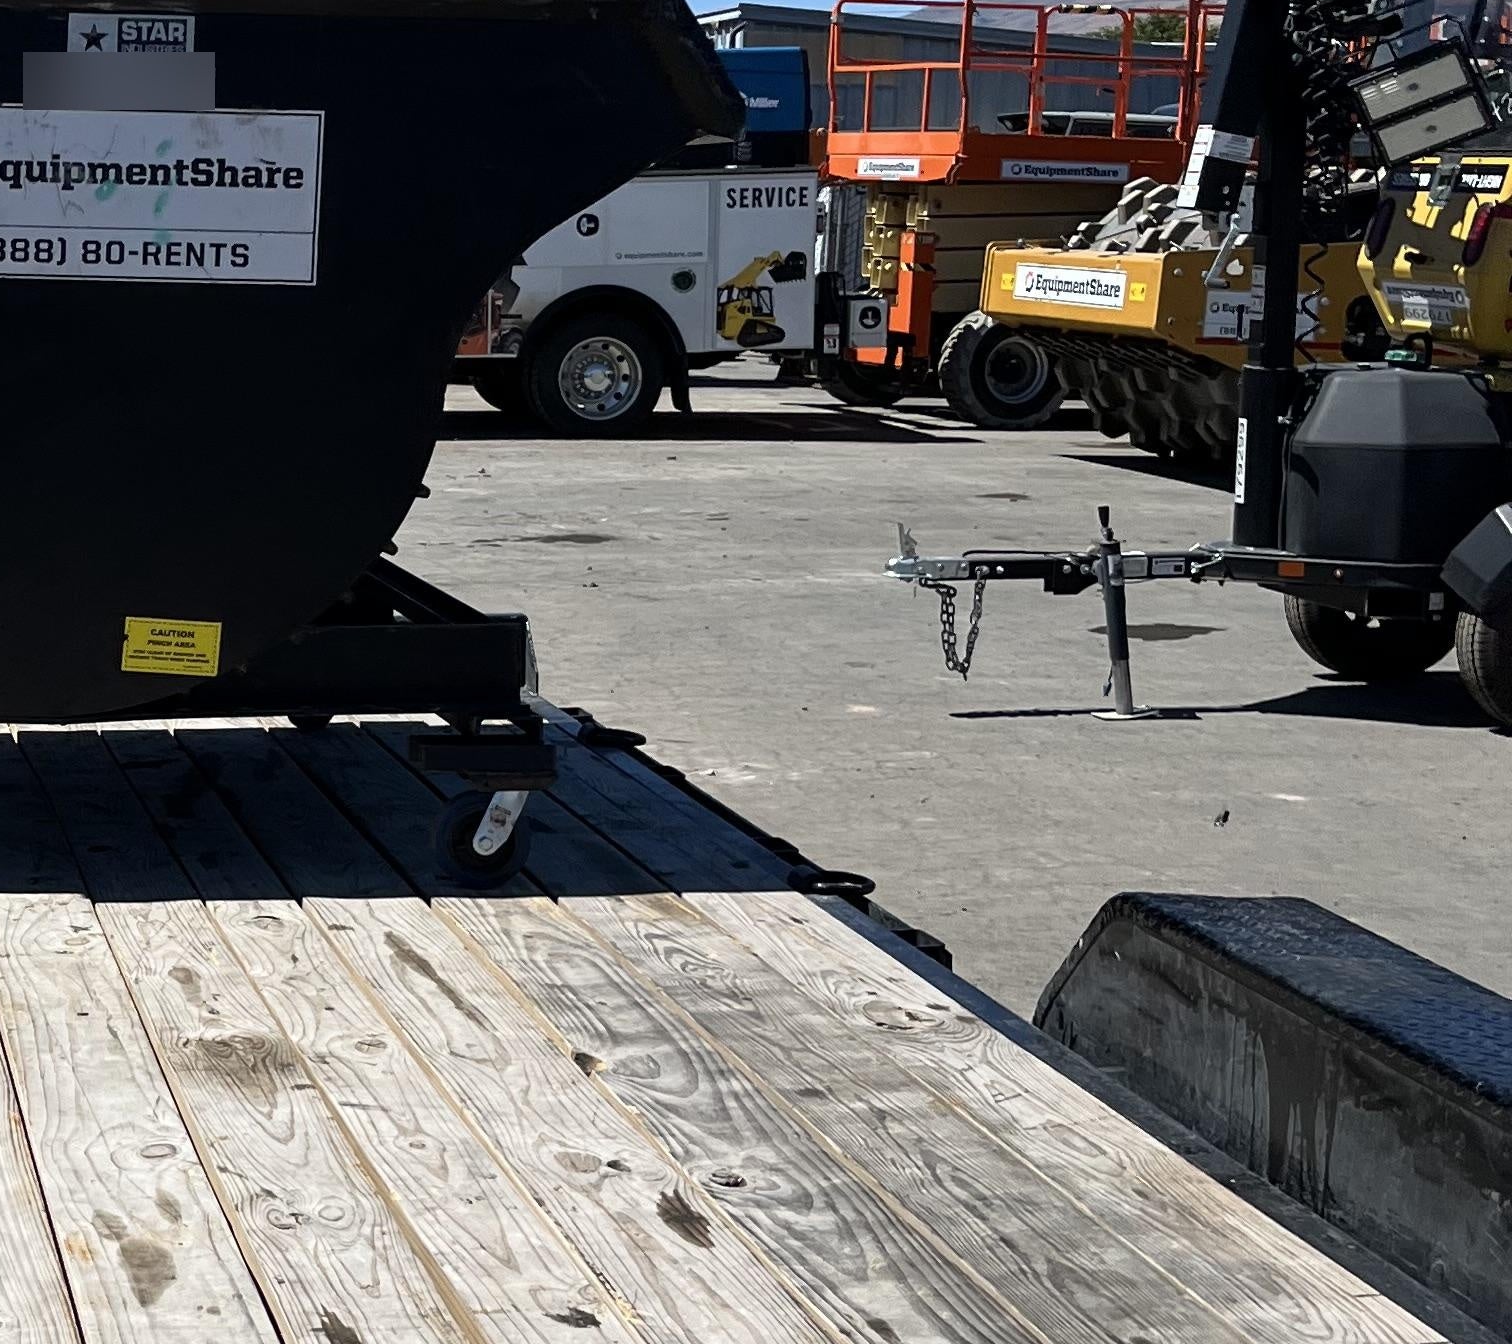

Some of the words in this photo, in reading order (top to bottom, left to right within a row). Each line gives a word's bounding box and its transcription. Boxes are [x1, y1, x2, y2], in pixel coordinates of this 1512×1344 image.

[121, 20, 185, 42] STAR
[1024, 164, 1120, 177] EquipmentShare
[726, 186, 809, 209] SERVICE
[81, 240, 250, 268] 80-RENTS
[1035, 273, 1121, 298] EquipmentShare
[150, 628, 194, 638] CAUTION
